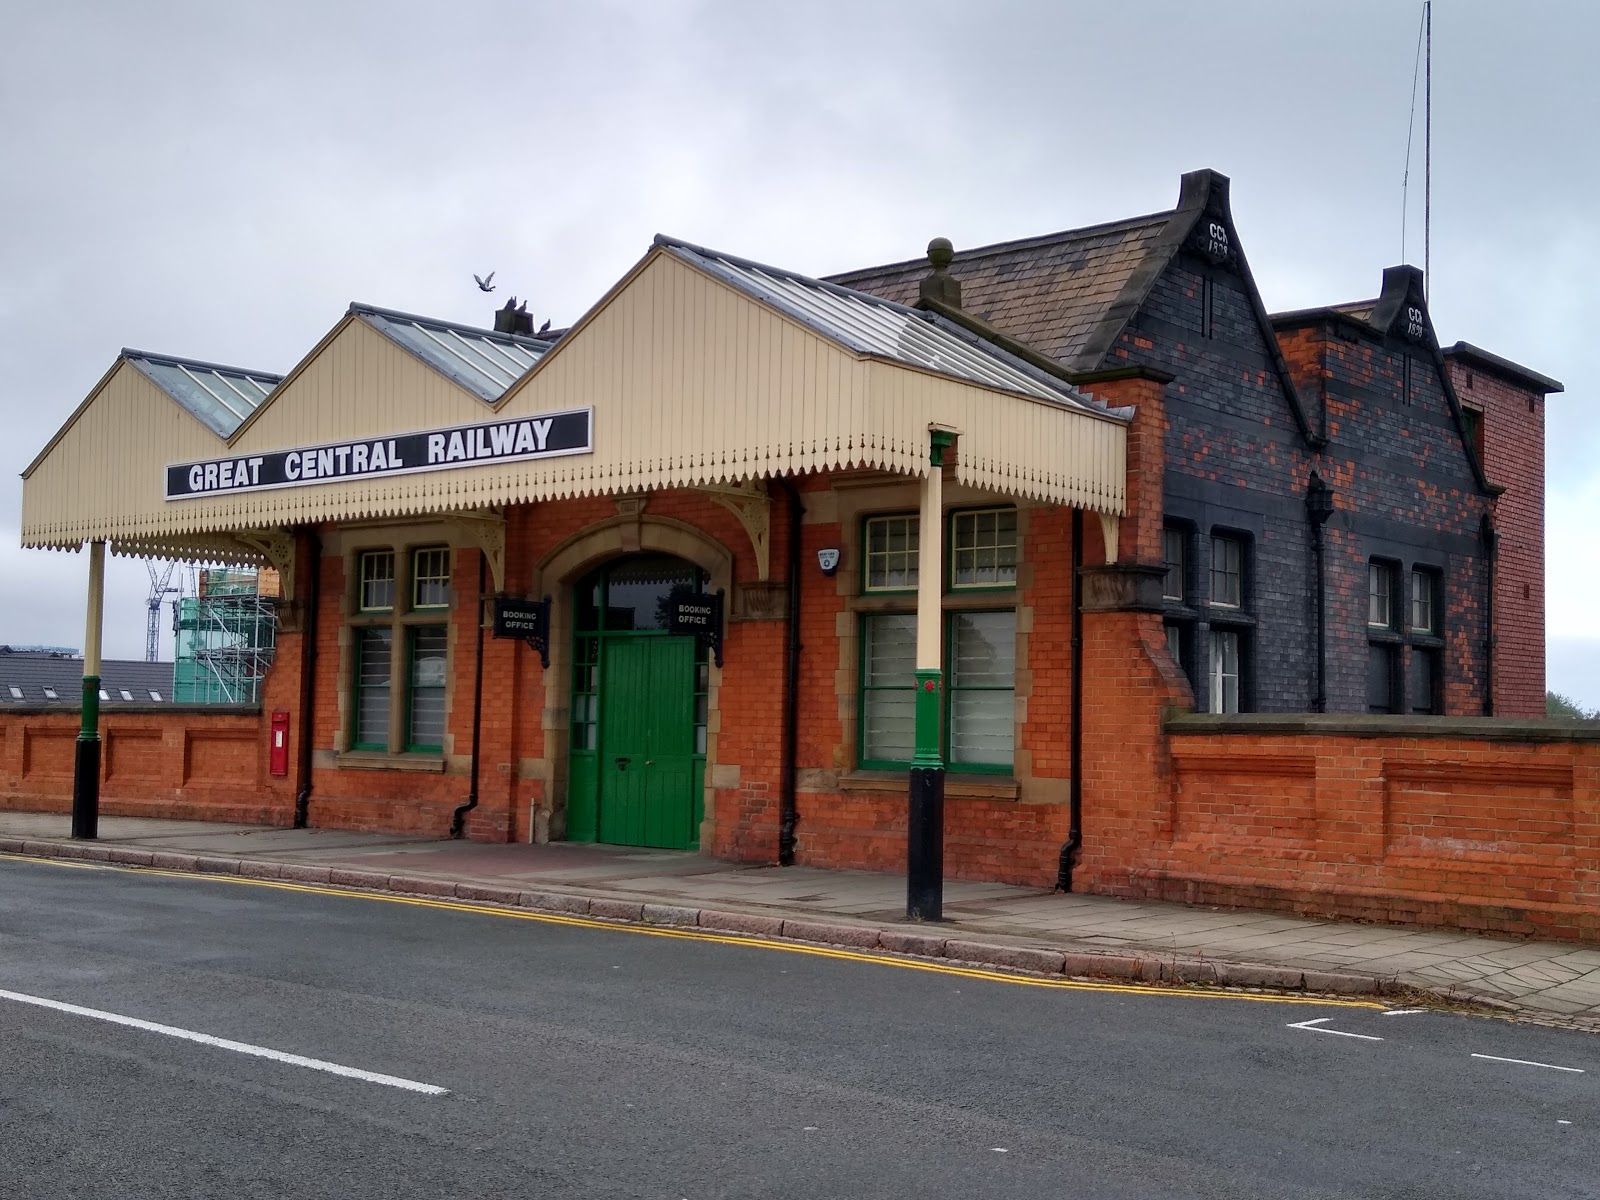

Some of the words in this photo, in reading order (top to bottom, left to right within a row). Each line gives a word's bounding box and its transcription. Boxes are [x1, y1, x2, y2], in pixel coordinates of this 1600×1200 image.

[188, 458, 264, 492] GREAT
[284, 440, 403, 480] CENTRAL
[428, 418, 553, 464] RAILWAY
[678, 604, 711, 615] BOOKING
[502, 610, 537, 620] BOOKING
[678, 615, 707, 625] OFFICE
[505, 620, 535, 630] OFFICE
